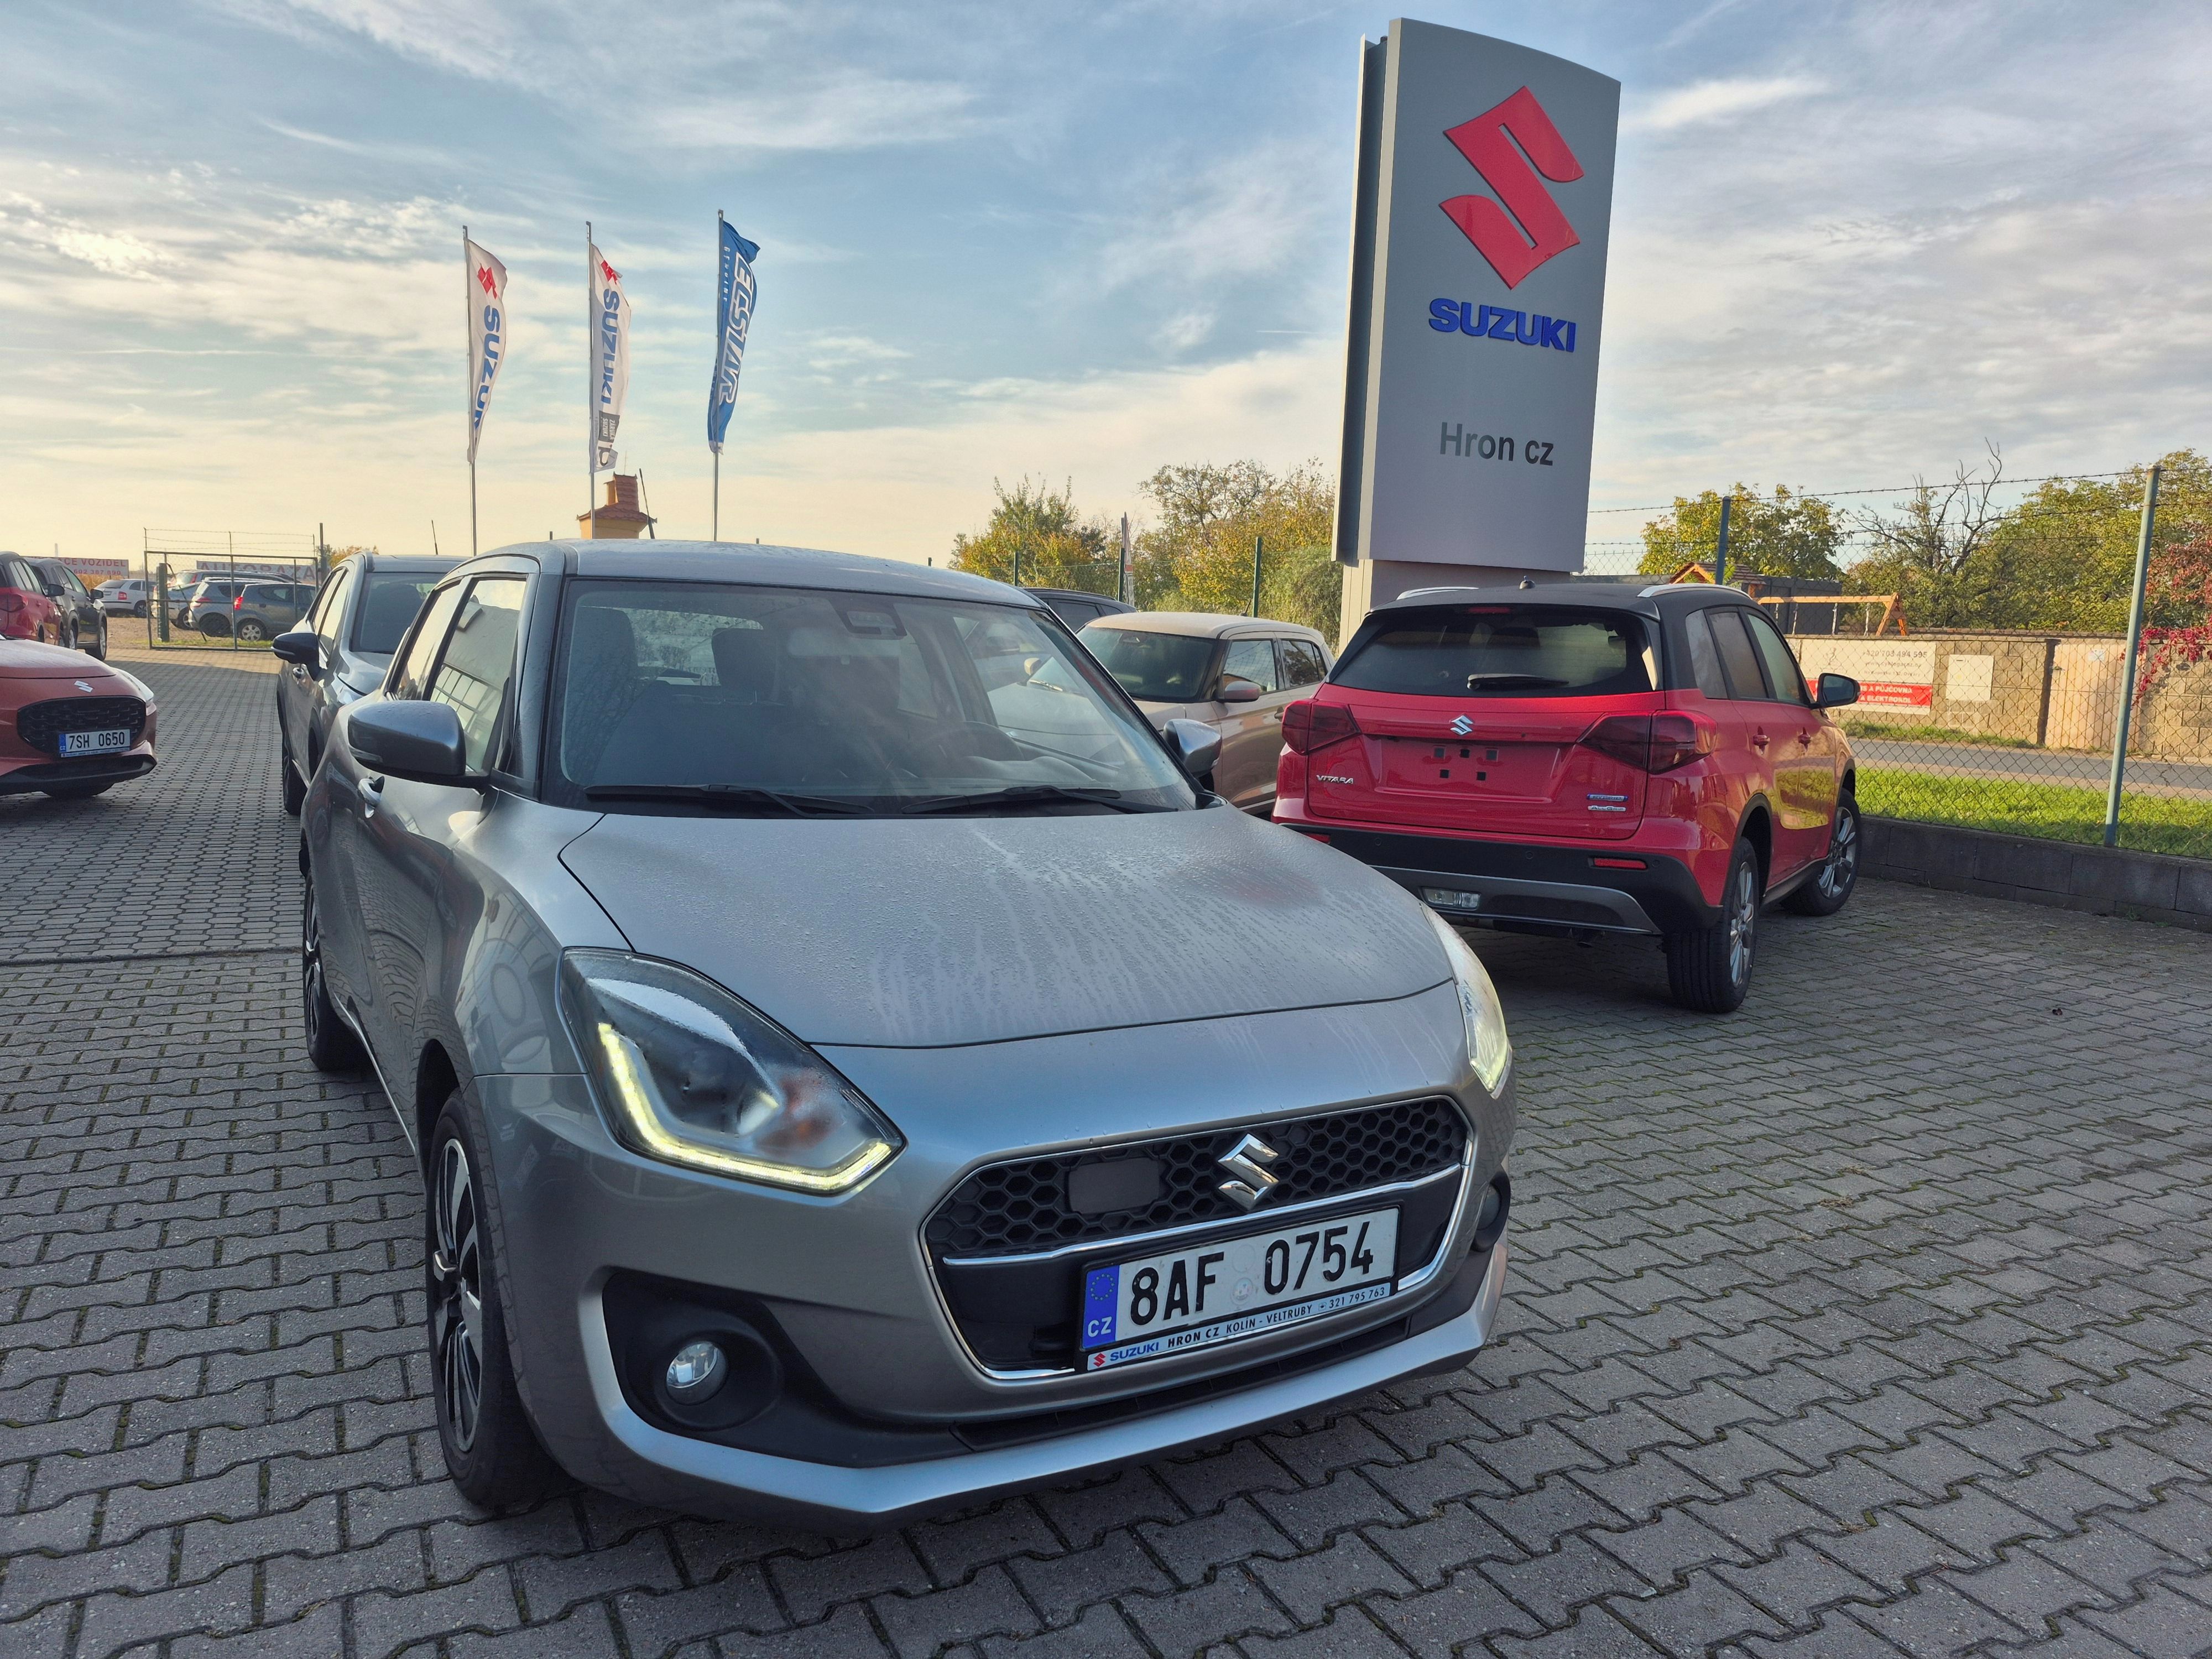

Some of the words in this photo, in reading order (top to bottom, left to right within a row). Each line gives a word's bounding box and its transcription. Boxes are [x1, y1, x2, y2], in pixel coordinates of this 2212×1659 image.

[599, 288, 620, 405] SUZUKI
[719, 251, 754, 405] ECSTAR
[1428, 298, 1577, 352] SUZUKI
[474, 305, 500, 430] SUZUK
[1440, 421, 1514, 461] Hron
[1525, 440, 1554, 466] cz
[81, 559, 126, 567] VOZIDEL
[69, 734, 89, 749] 7SH
[98, 732, 124, 747] 0650
[1316, 775, 1354, 784] VITARA
[1130, 1251, 1224, 1326] 8AF
[1264, 1221, 1374, 1295] 0754
[1087, 1316, 1113, 1338] CZ
[1110, 1342, 1159, 1361] SUZUKI
[1168, 1332, 1201, 1348] HRON
[1206, 1327, 1219, 1338] CZ
[1226, 1317, 1255, 1334] KOLÍN
[1266, 1305, 1312, 1324] VELTRUBY
[1329, 1297, 1344, 1309] 321
[1349, 1292, 1365, 1303] 795
[1369, 1287, 1385, 1299] 763
